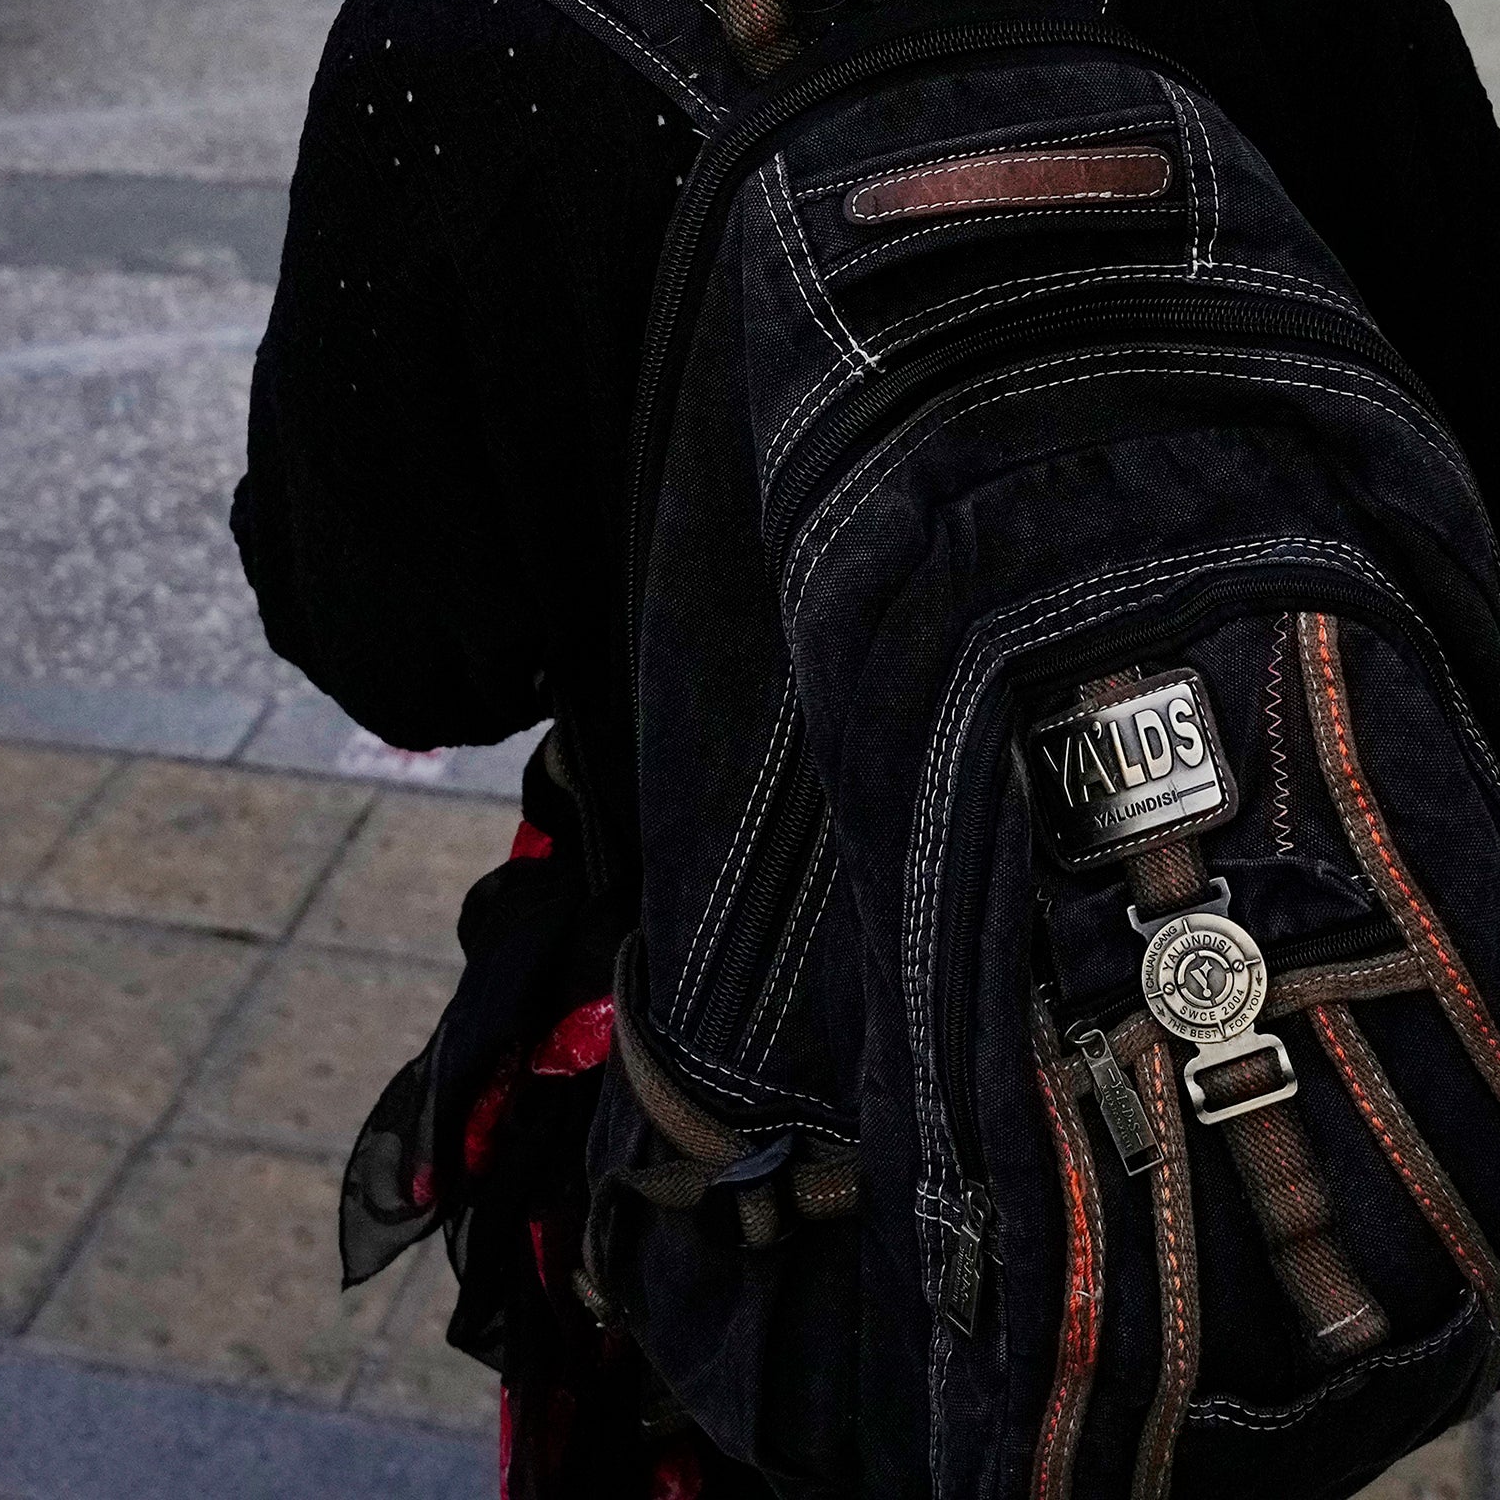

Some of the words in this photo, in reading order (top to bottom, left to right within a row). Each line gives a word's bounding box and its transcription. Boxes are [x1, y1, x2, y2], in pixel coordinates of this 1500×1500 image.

[1094, 790, 1179, 828] YALUNDISI
[1146, 950, 1159, 989] CHUAN
[1153, 925, 1178, 951] GANG
[1162, 934, 1232, 972] YALUNDISI
[1168, 1019, 1186, 1035] THE
[1190, 1029, 1219, 1039] BEST
[1229, 1013, 1250, 1032] FOR
[1247, 990, 1262, 1013] YOU
[1180, 1005, 1217, 1021] SWCE
[1221, 989, 1244, 1015] 2004
